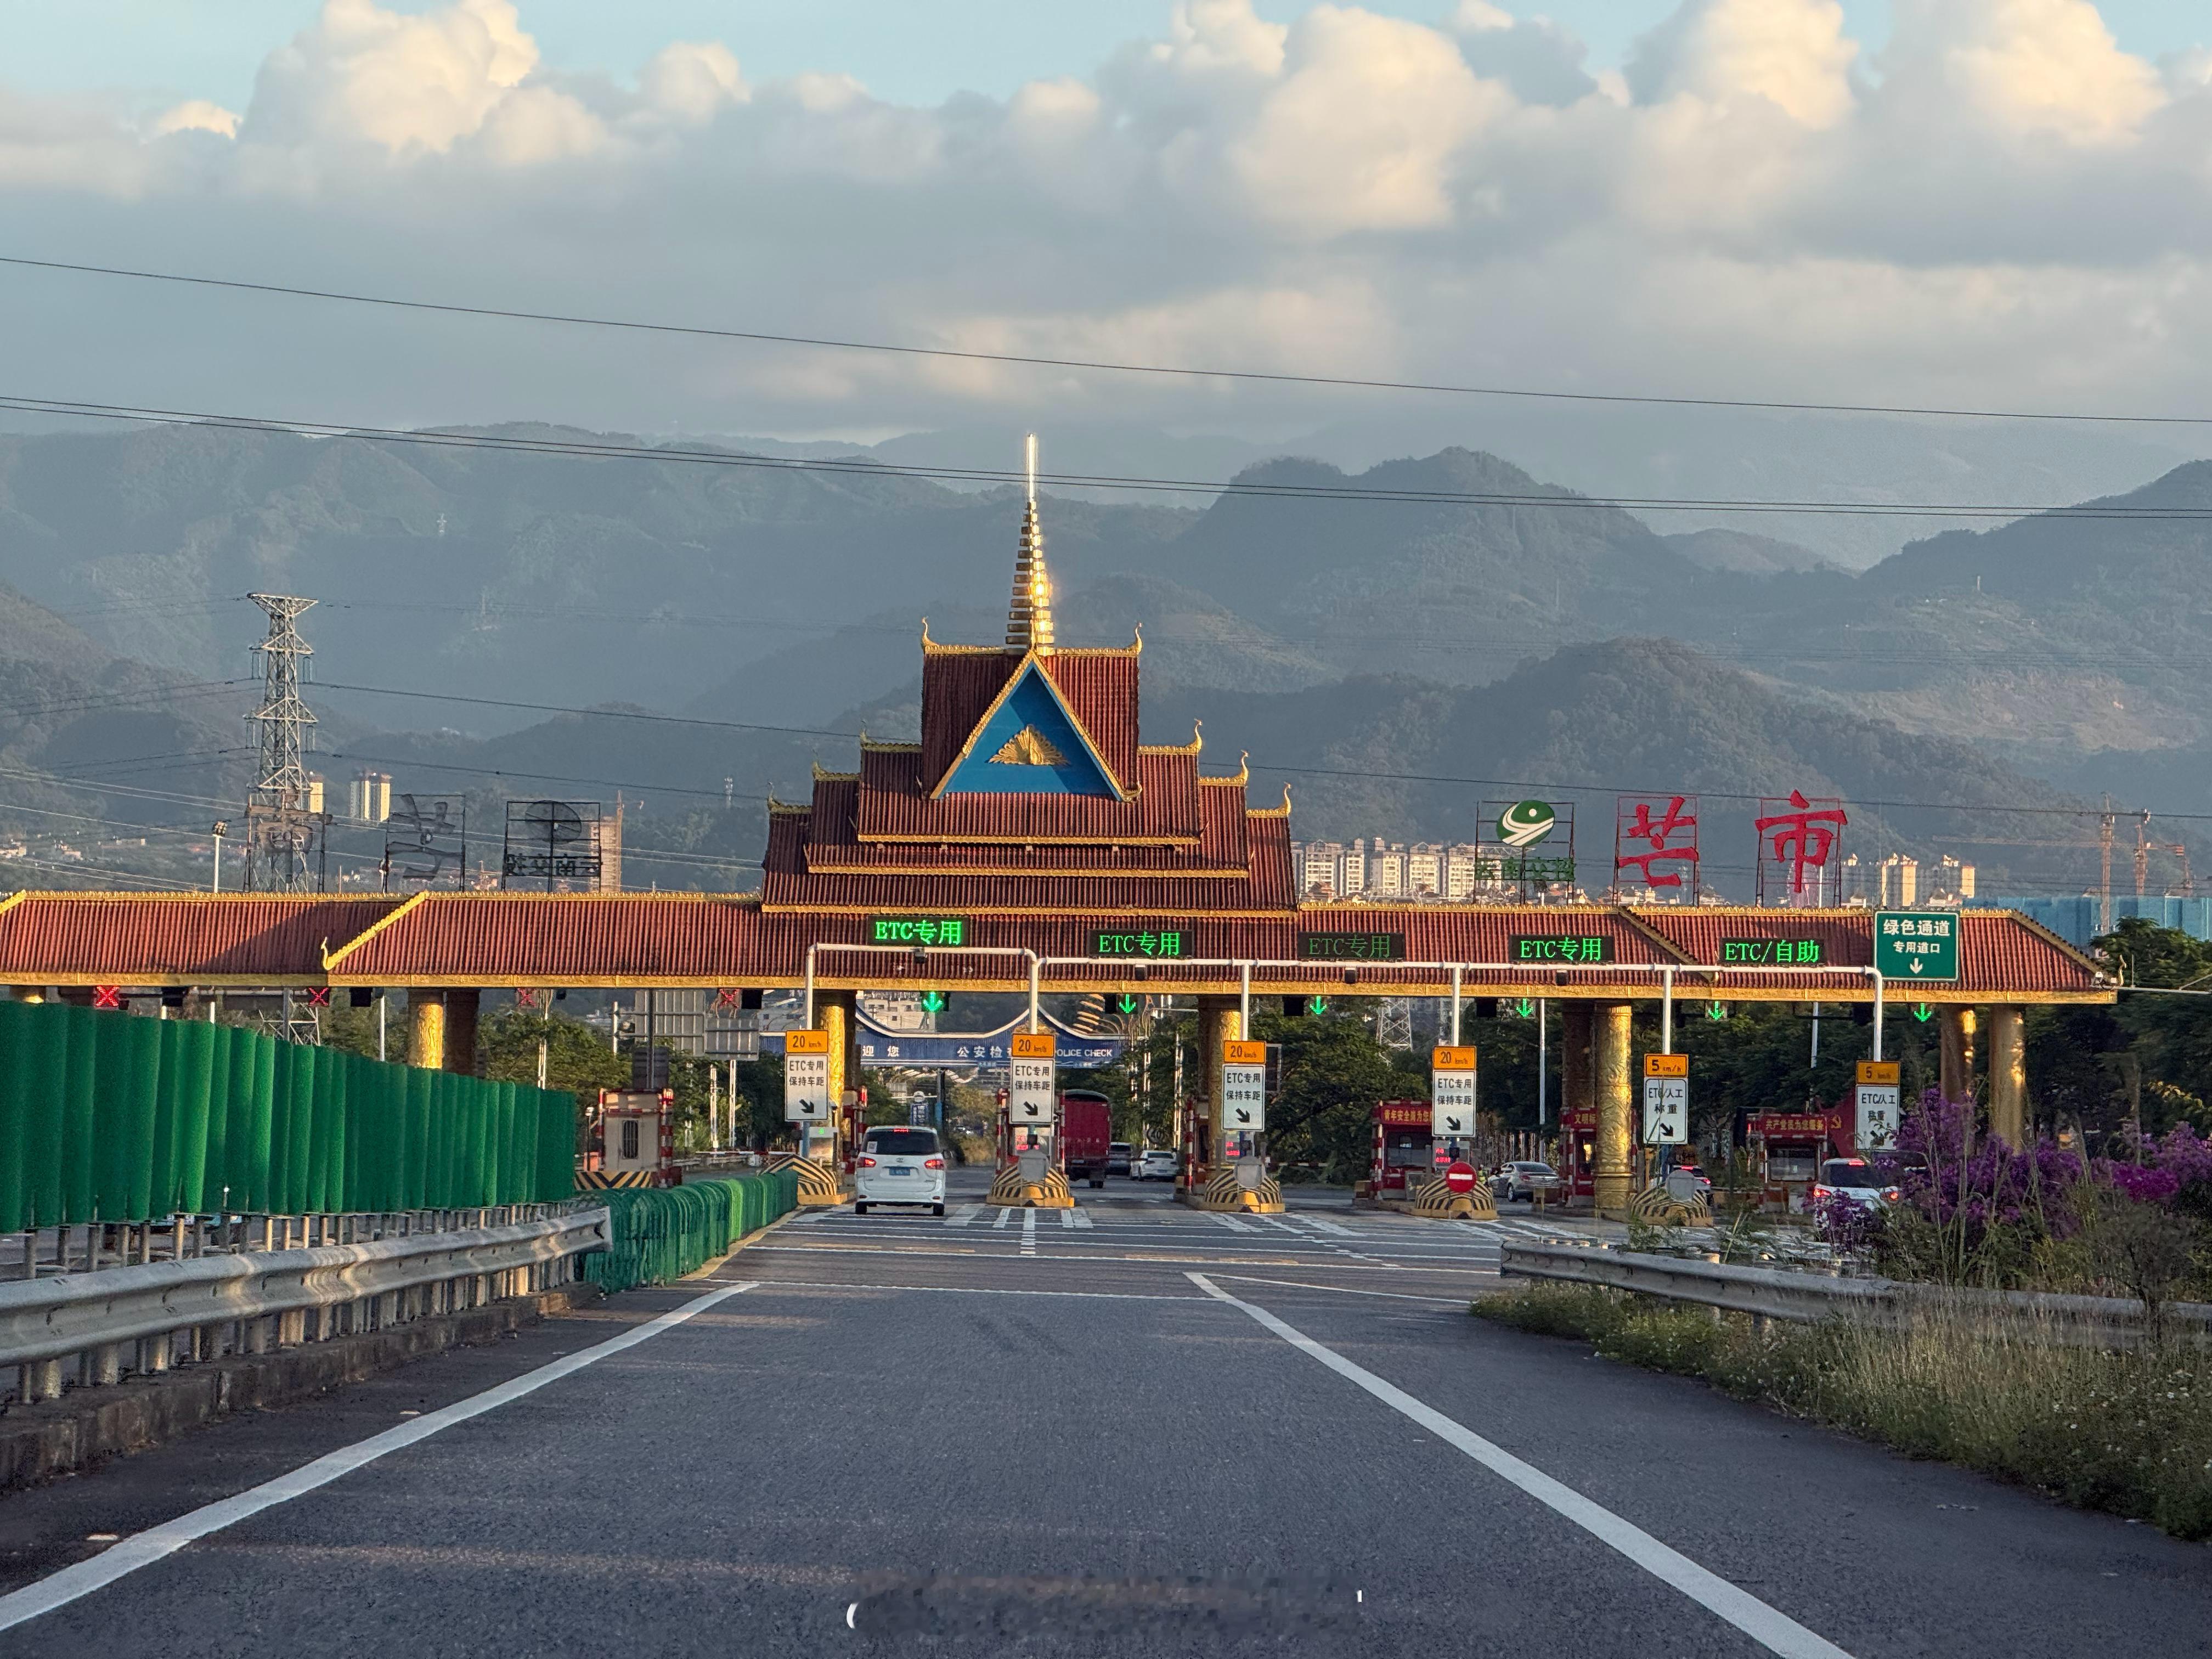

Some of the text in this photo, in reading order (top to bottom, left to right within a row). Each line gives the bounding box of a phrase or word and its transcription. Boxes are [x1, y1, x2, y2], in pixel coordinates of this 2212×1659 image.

[1617, 789, 1847, 894] 芒市
[876, 921, 962, 945] ETC专用
[1883, 919, 1950, 936] 绿色通道
[1099, 932, 1180, 955] ETC专用
[1308, 935, 1390, 958] ETC专用
[1521, 938, 1601, 961] ETC专用
[1893, 940, 1940, 954] 专用道口
[1726, 940, 1819, 962] ETC/自助
[792, 1035, 805, 1048] 20
[1018, 1039, 1031, 1052] 20
[862, 1045, 900, 1058] 迎您
[1056, 1049, 1082, 1057] OLICE
[1084, 1049, 1113, 1057] CHECK
[1230, 1045, 1243, 1058] 20
[1440, 1051, 1452, 1064] 20
[789, 1060, 824, 1071] ETC专用
[1015, 1065, 1049, 1076] ETC专用
[1651, 1059, 1660, 1071] 5
[1227, 1073, 1261, 1084] ETC专用
[1866, 1066, 1872, 1079] 5
[789, 1076, 825, 1086] 保持车距
[1015, 1080, 1050, 1091] 保持车距
[1437, 1078, 1472, 1089] ETC专用
[1226, 1090, 1261, 1101] 保持车距
[1437, 1095, 1472, 1105] 保持车距
